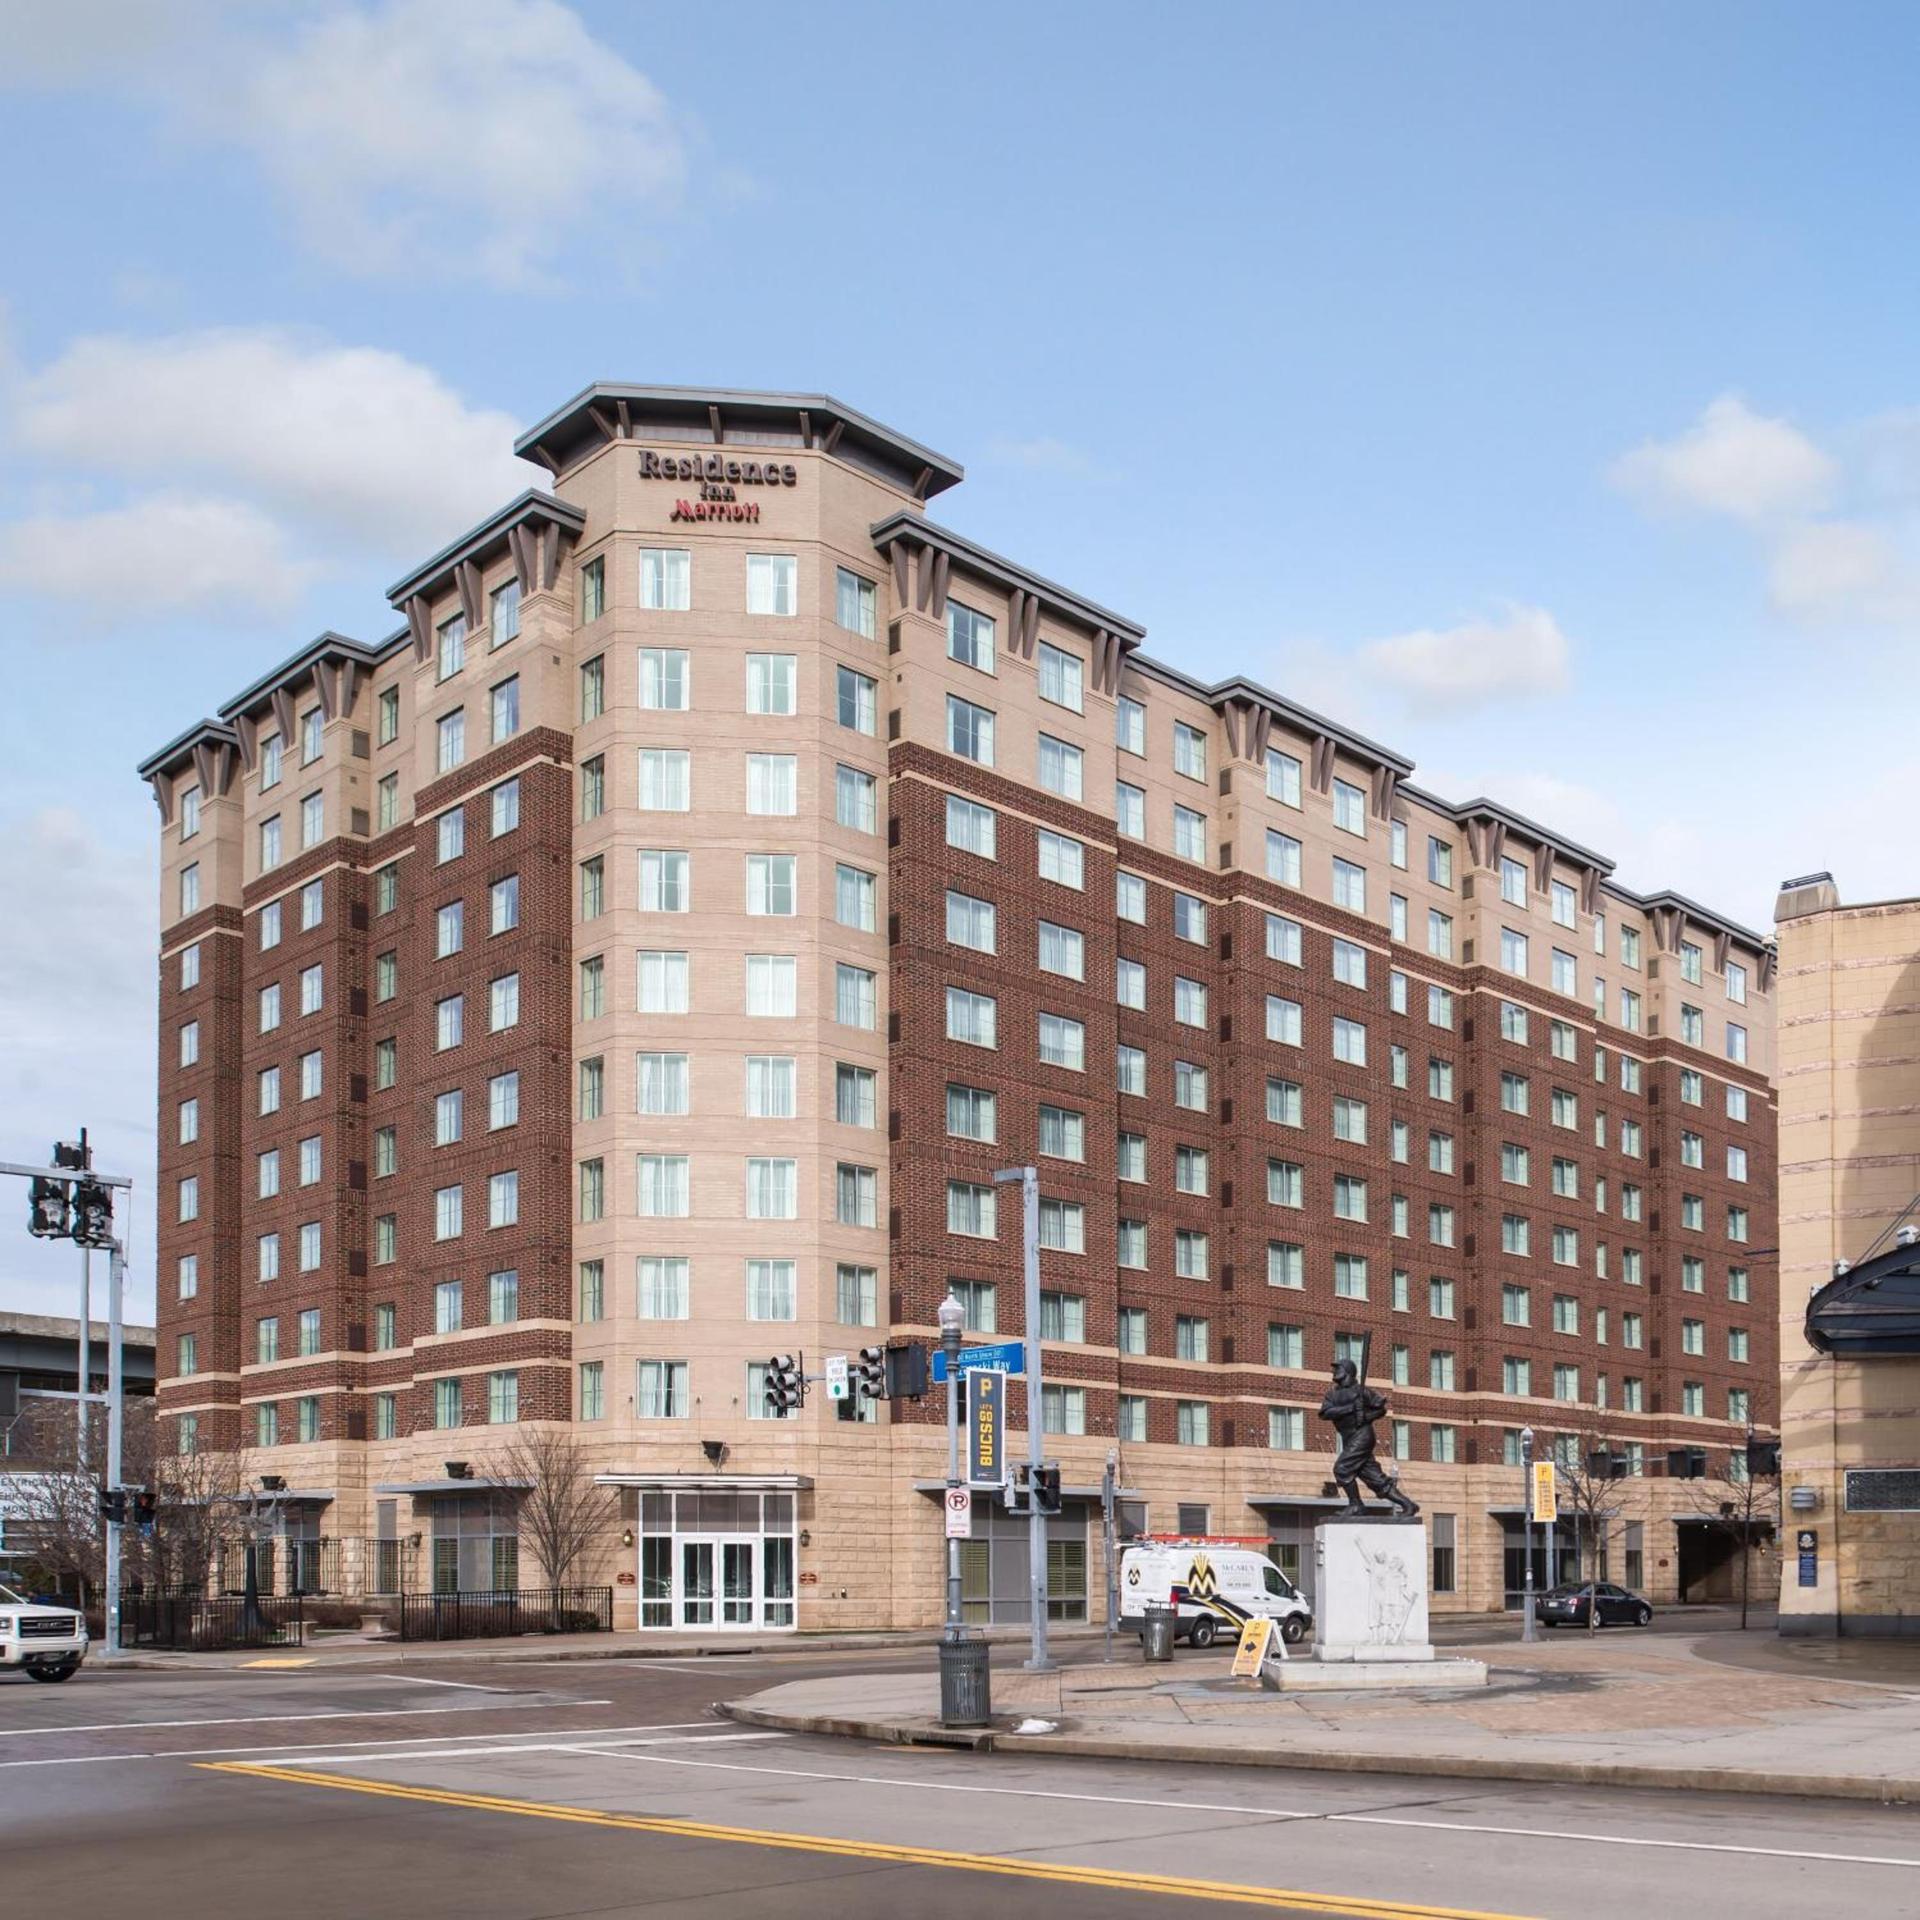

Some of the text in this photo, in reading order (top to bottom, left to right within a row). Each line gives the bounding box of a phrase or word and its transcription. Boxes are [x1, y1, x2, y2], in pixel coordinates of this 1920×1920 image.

[638, 449, 797, 487] Residence
[700, 481, 736, 501] Inn
[670, 498, 760, 523] Marriott
[992, 1360, 1011, 1372] Way
[980, 1422, 993, 1467] BUCS
